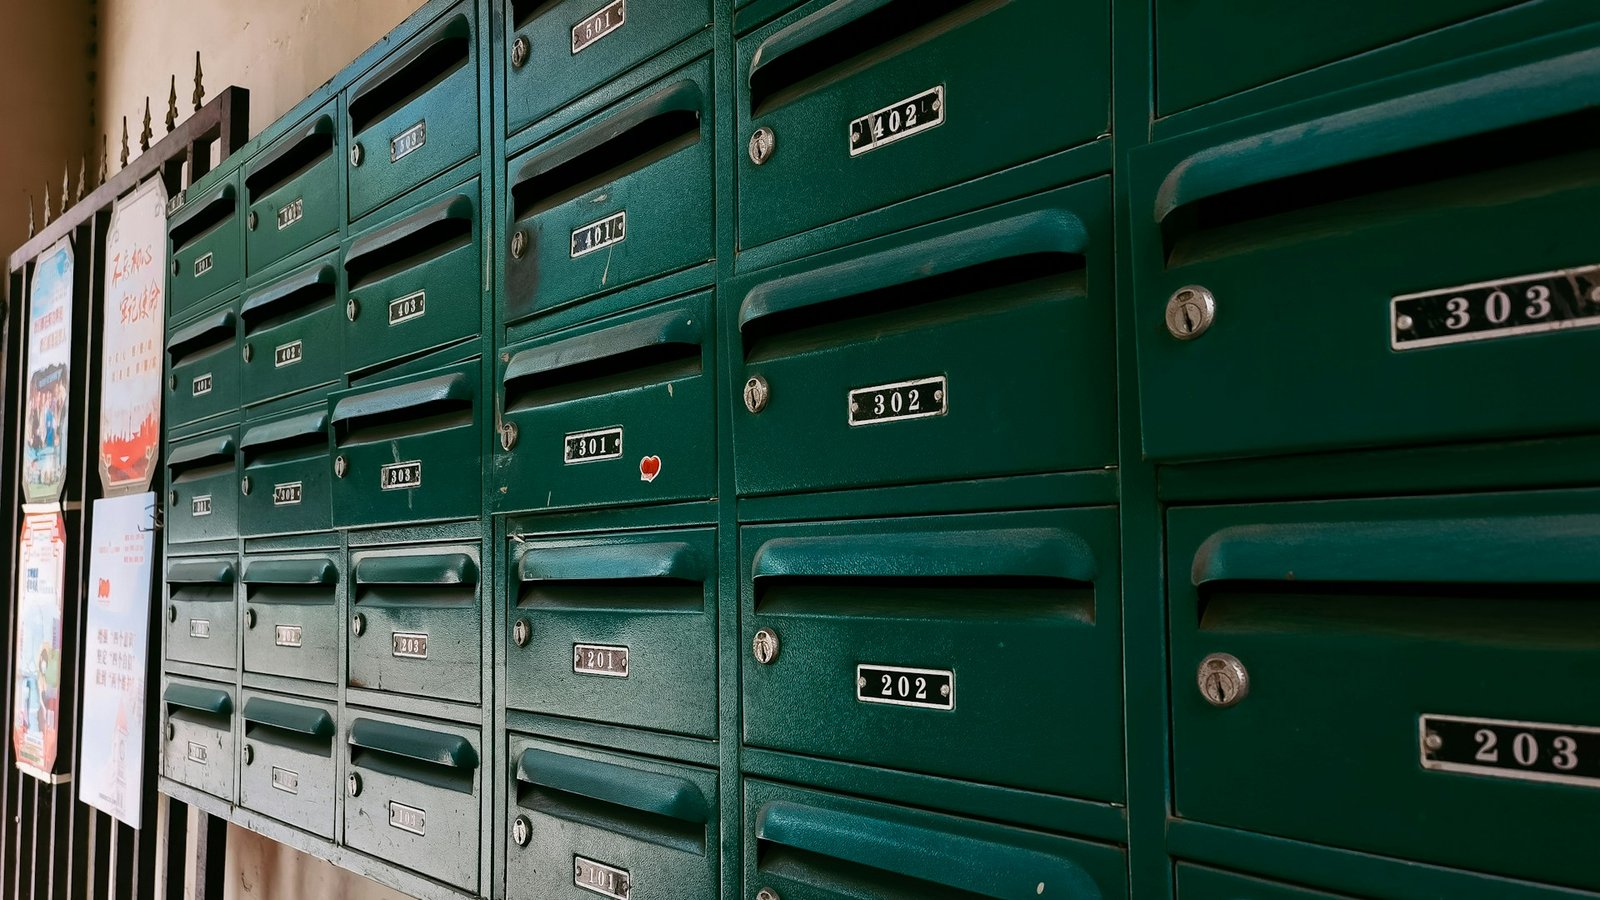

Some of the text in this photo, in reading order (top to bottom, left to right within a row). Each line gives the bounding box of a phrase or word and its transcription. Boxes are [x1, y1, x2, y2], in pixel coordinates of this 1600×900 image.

[585, 12, 610, 40] 501
[873, 104, 917, 138] 402
[585, 221, 611, 249] 401
[399, 299, 416, 316] 403
[1445, 284, 1551, 328] 303
[282, 346, 295, 361] 402
[874, 389, 920, 415] 302
[579, 436, 606, 456] 301
[391, 468, 410, 483] 303
[402, 638, 419, 653] 203
[588, 651, 613, 669] 201
[881, 672, 927, 699] 202
[1474, 729, 1578, 769] 203
[589, 868, 613, 895] 101
